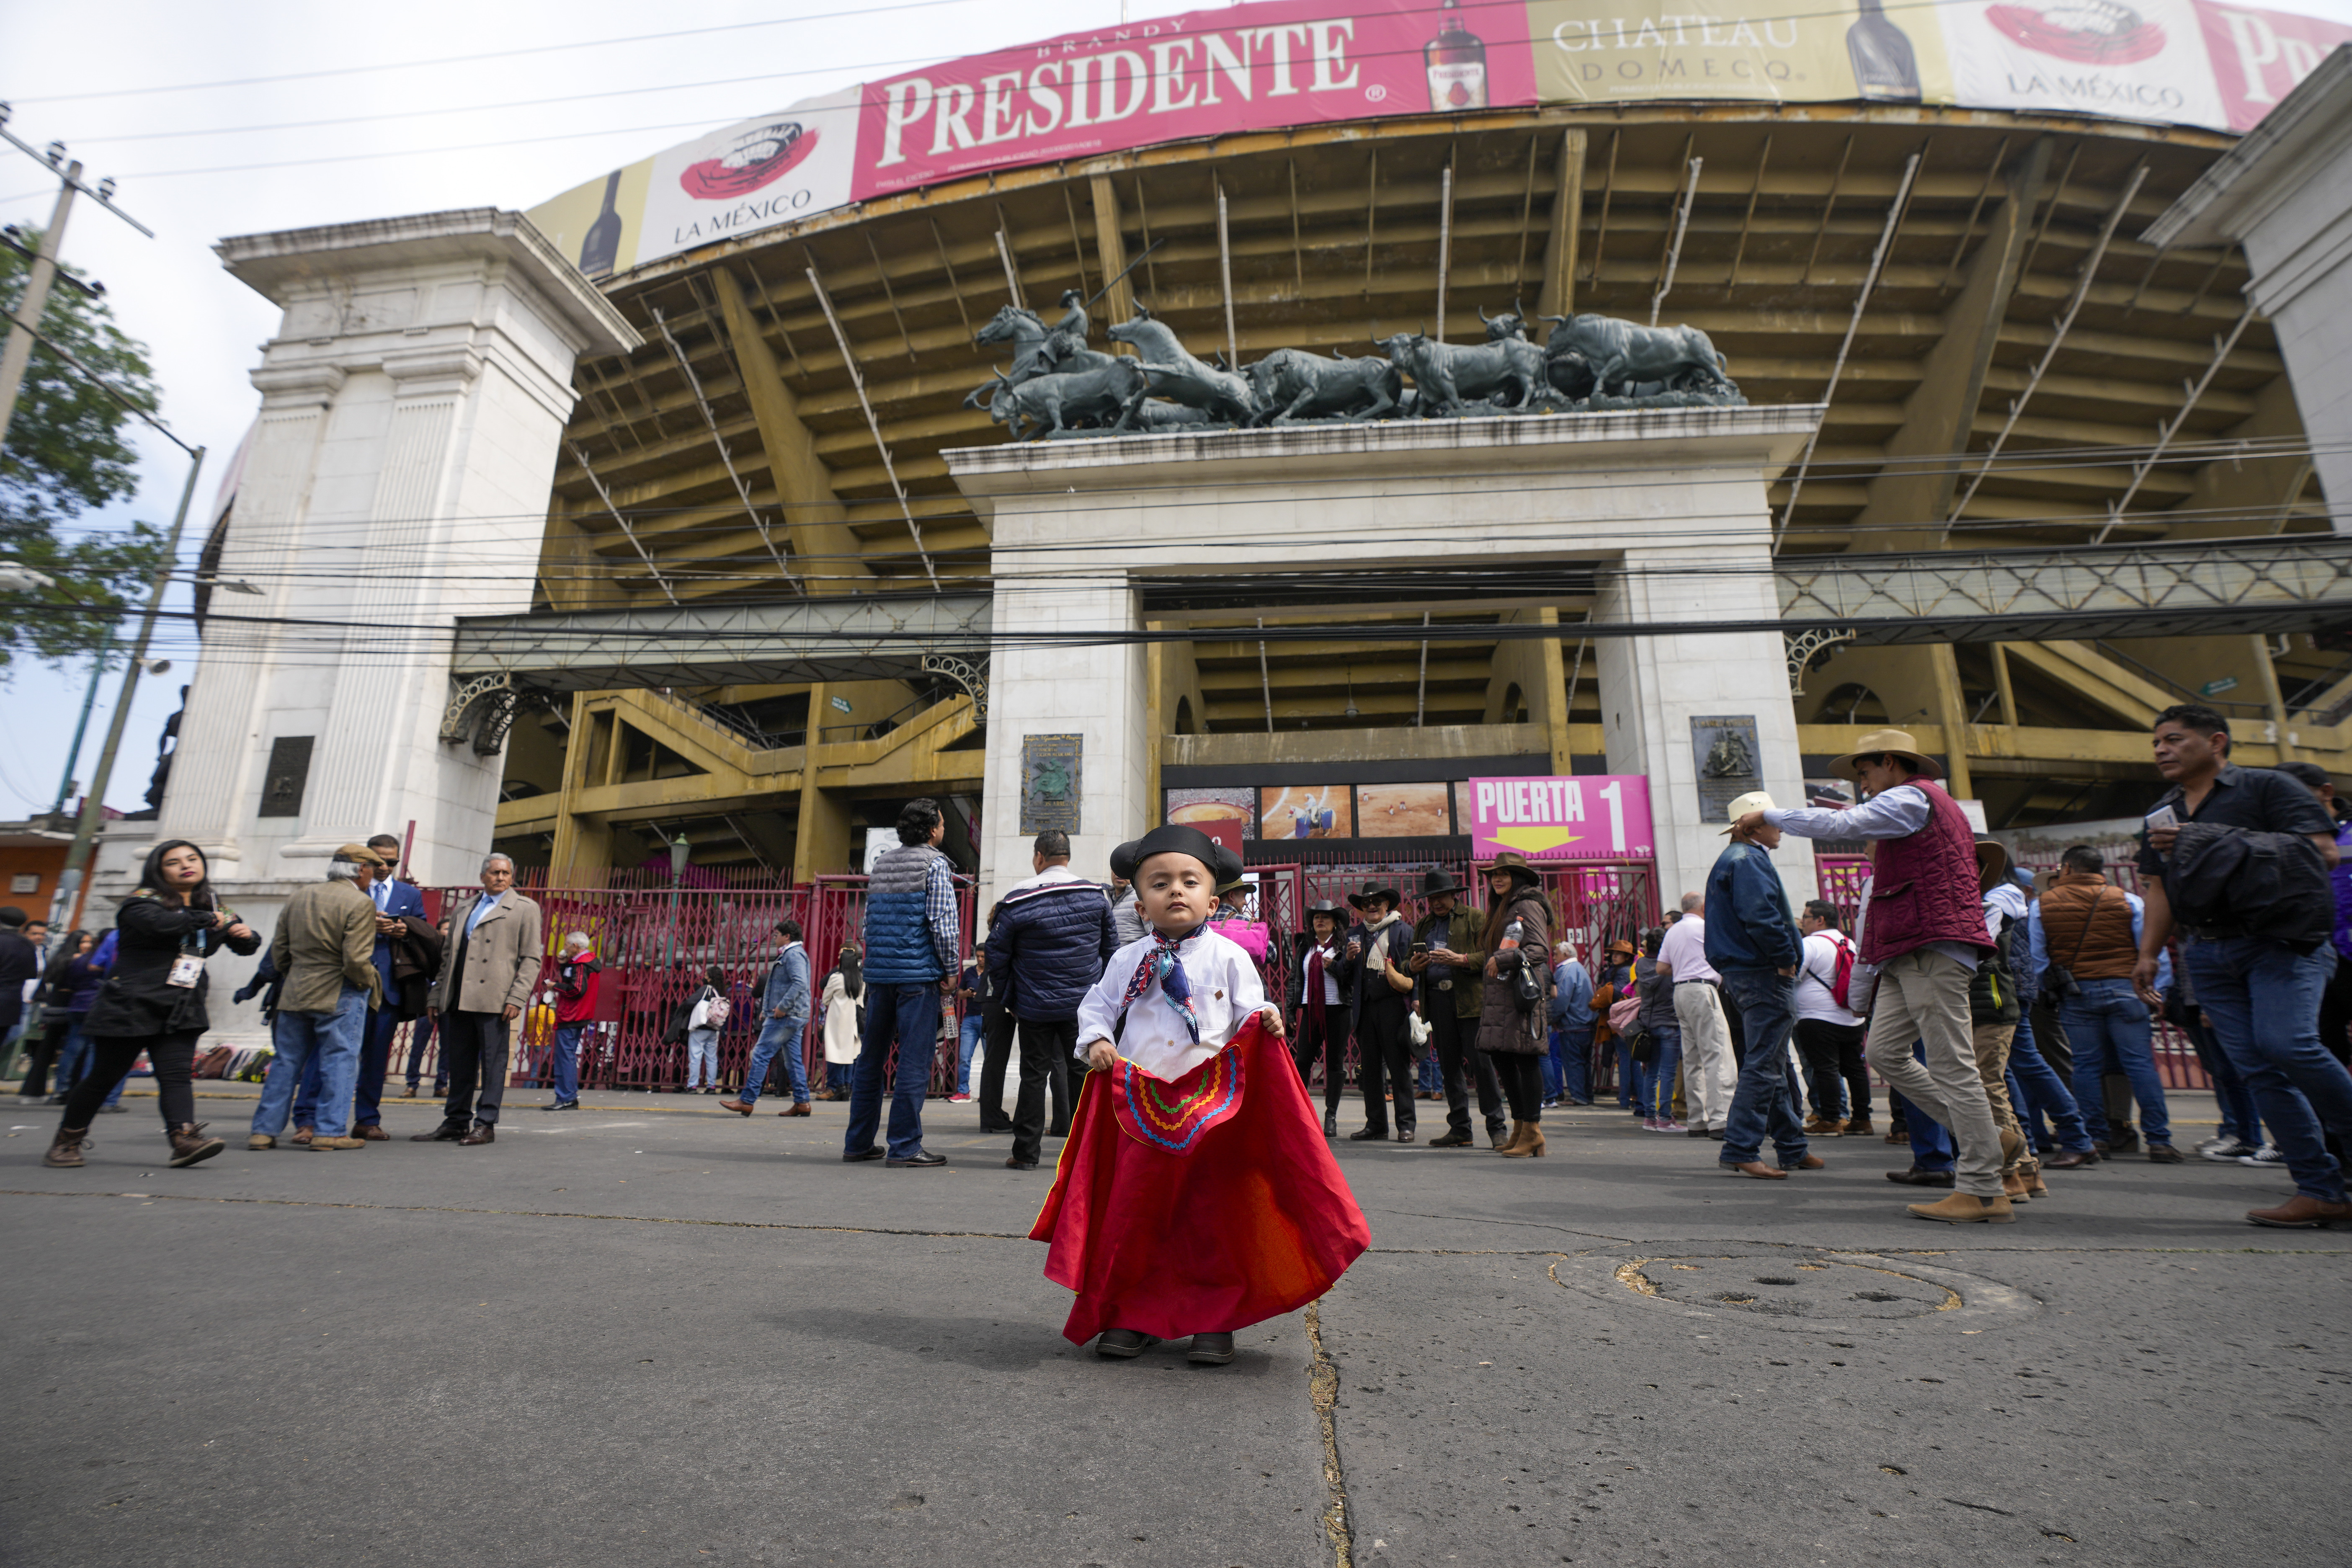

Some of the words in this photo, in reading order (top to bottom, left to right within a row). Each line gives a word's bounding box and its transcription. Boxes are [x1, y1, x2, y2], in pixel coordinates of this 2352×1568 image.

[1036, 18, 1187, 59] BRANDY
[1552, 13, 1798, 52] CHATEAU
[1582, 58, 1791, 81] DOMECQ
[875, 17, 1360, 168] PRESIDENTE
[2006, 74, 2049, 95] LA
[2058, 74, 2184, 109] MÉXICO
[674, 221, 701, 245] LA
[709, 188, 812, 234] MÉXICO
[1476, 780, 1586, 823] PUERTA
[1599, 780, 1626, 852] 1
